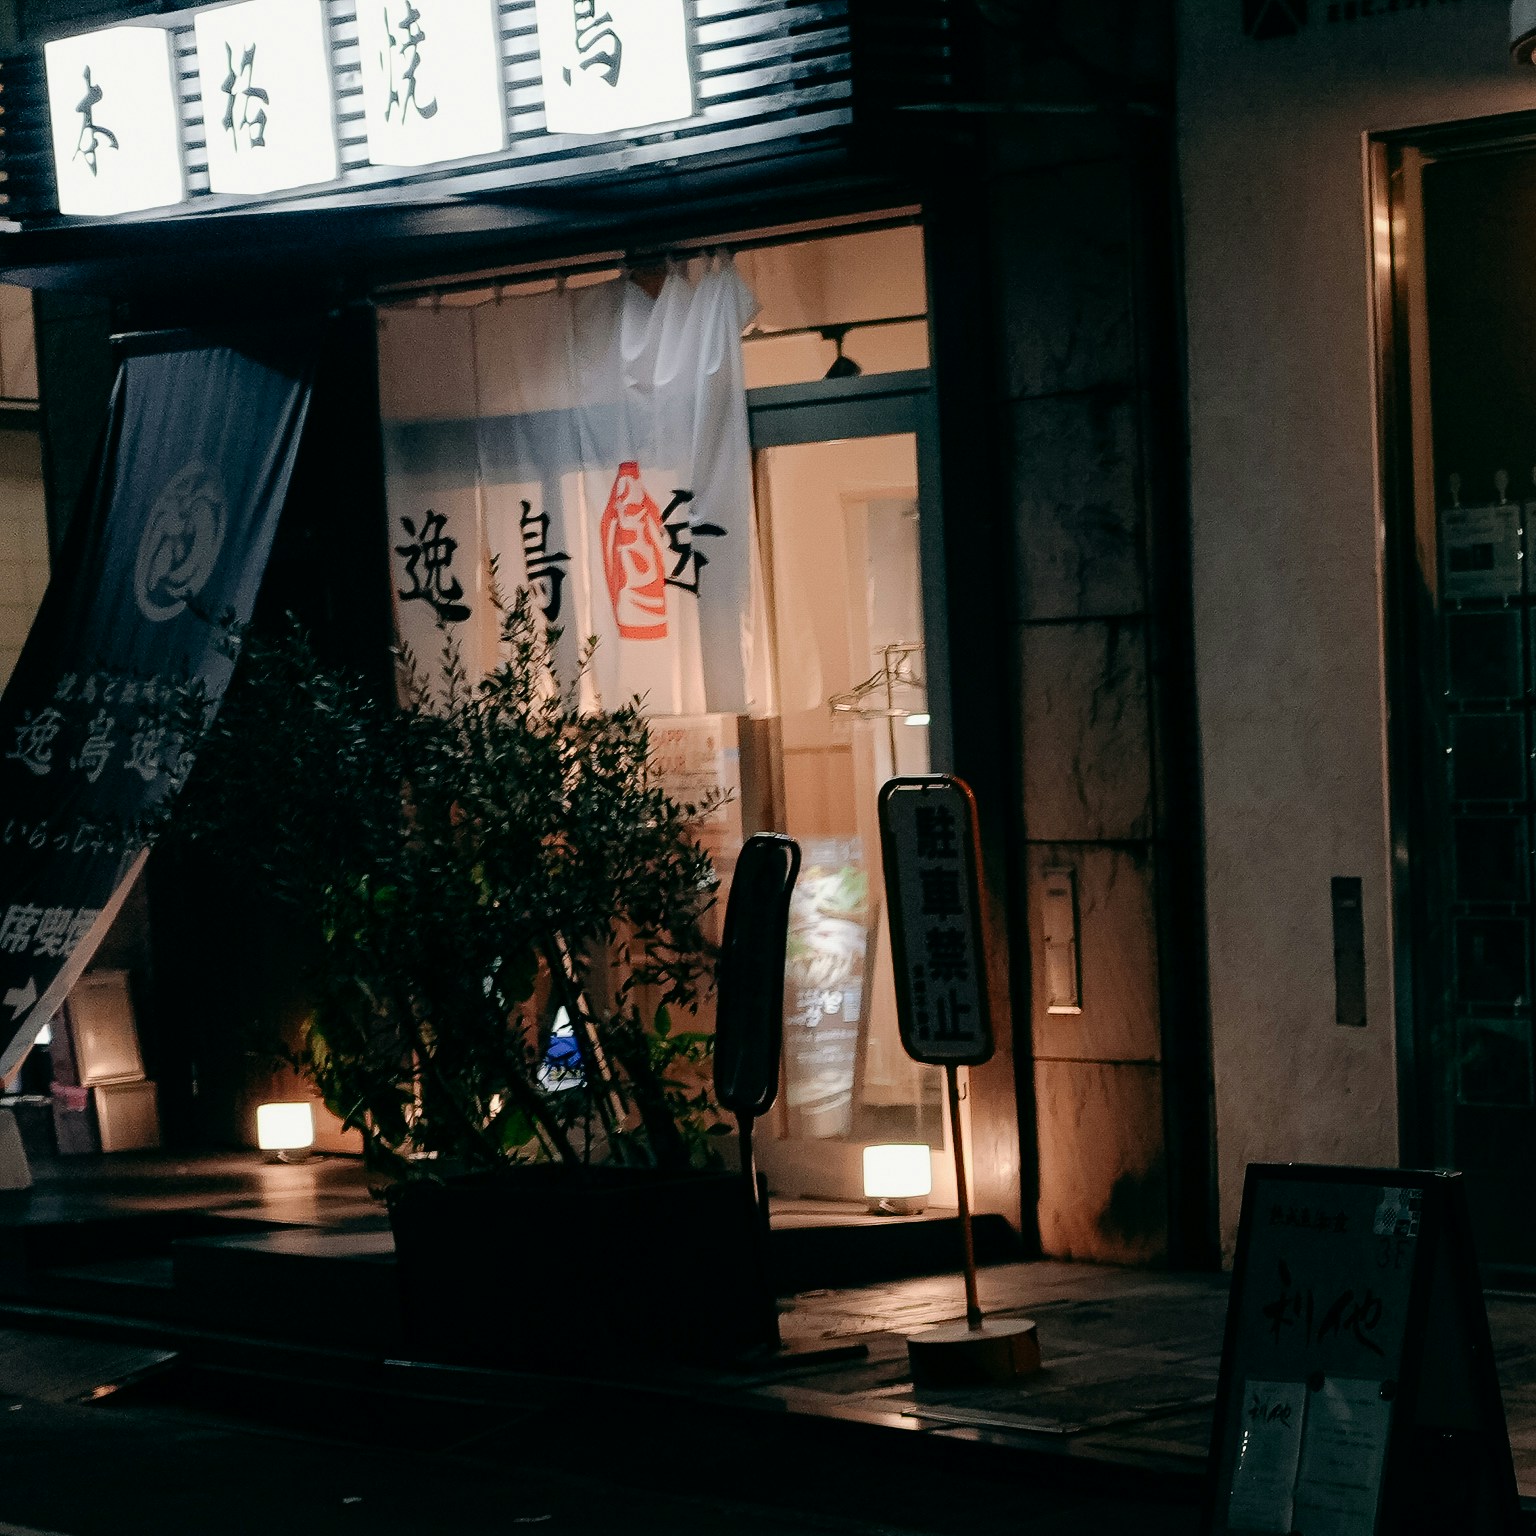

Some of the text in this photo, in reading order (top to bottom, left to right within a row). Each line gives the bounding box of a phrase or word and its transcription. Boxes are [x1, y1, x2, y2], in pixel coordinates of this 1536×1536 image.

[915, 803, 975, 1042] 駐車禁止
[1376, 1237, 1411, 1270] 3F
